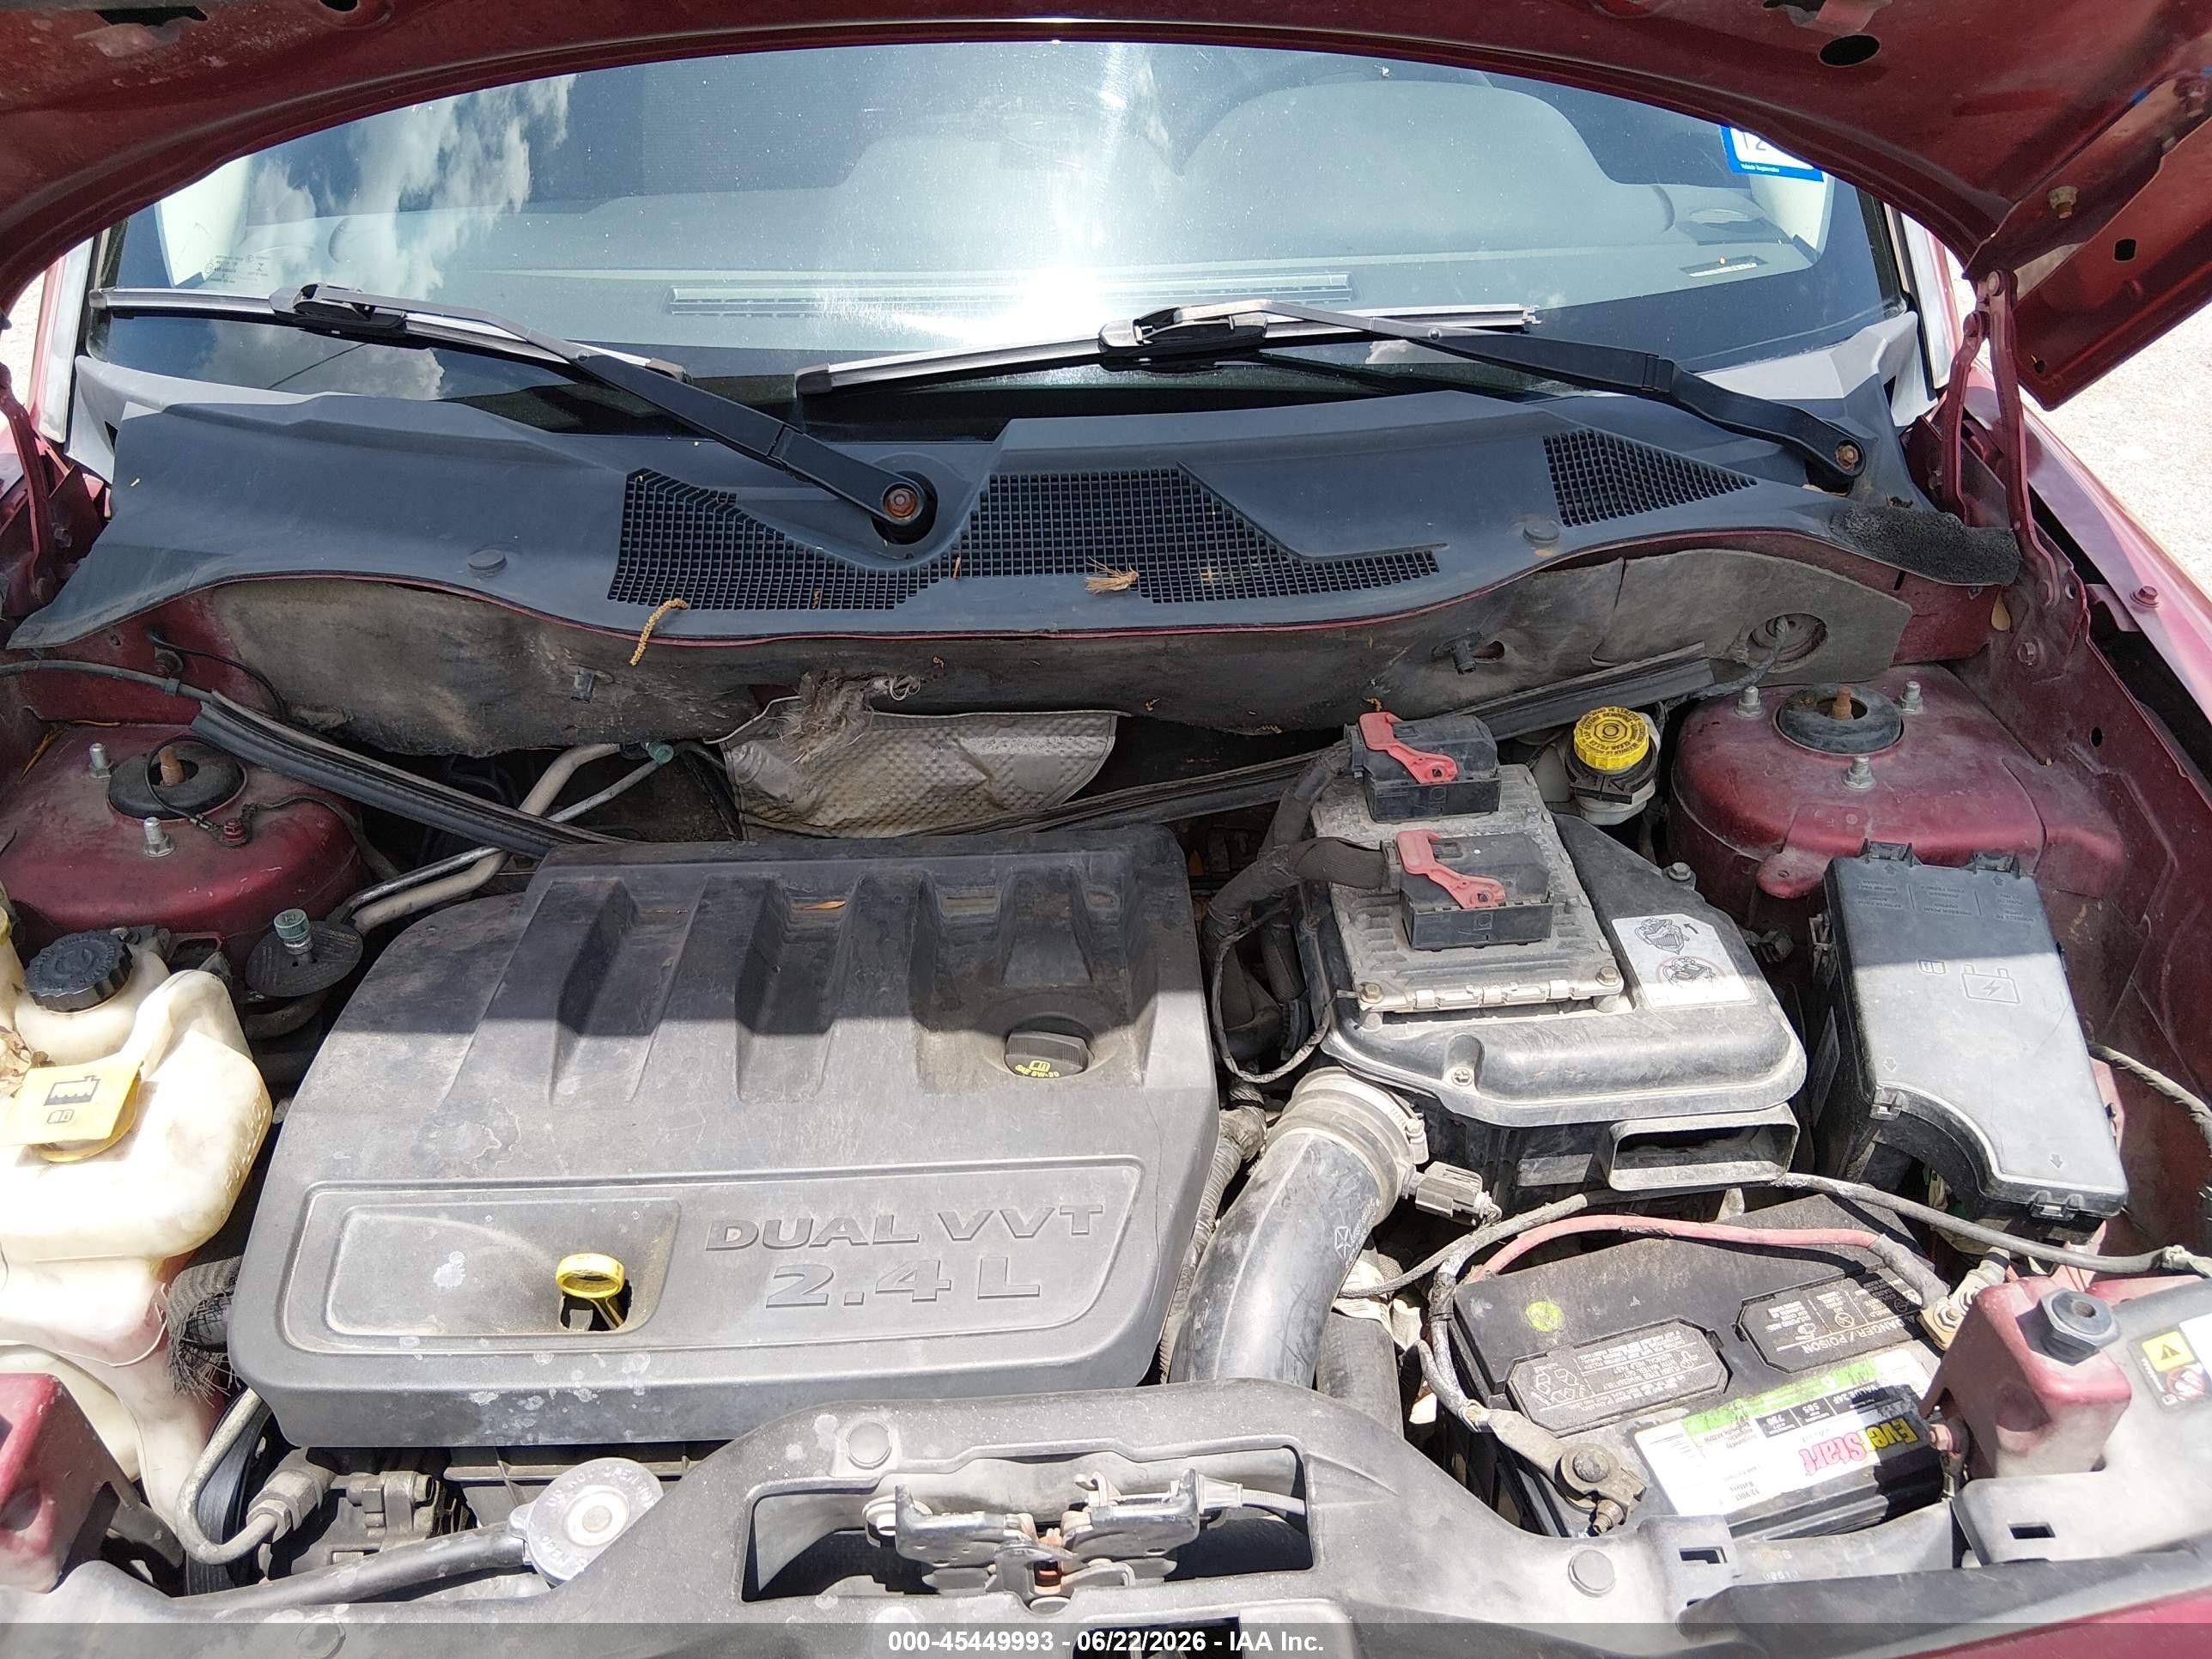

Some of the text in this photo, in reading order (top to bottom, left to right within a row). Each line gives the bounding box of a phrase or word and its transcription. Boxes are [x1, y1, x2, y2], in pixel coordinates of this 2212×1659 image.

[1015, 1064, 1032, 1076] SAE
[705, 1204, 1103, 1251] DUAL VVT
[1856, 1317, 1905, 1339] DANGER
[1801, 1334, 1847, 1354] POISON
[1832, 1383, 1879, 1405] VALUE 24F
[1799, 1417, 1918, 1476] EverStart
